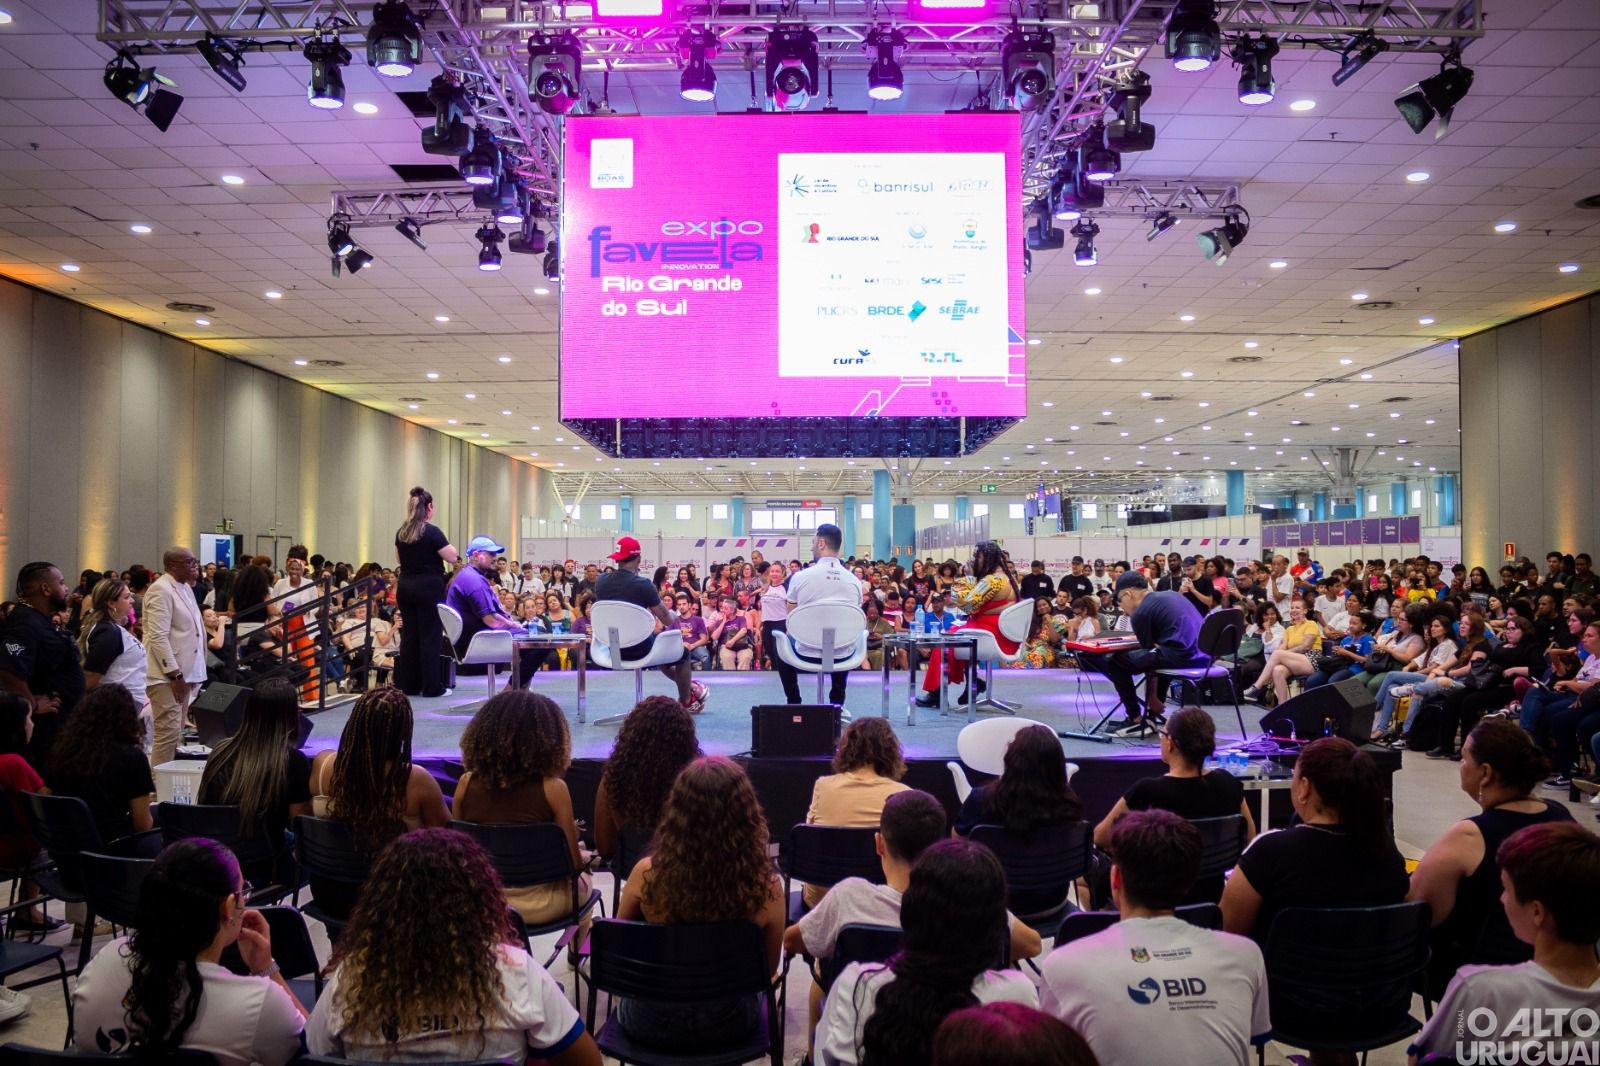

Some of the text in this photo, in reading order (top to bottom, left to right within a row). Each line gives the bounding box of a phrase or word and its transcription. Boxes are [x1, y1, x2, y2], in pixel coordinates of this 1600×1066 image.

[873, 181, 934, 193] banrisul
[661, 220, 764, 239] expo
[602, 275, 743, 292] Rio Grande
[601, 299, 687, 316] do Sul
[867, 306, 905, 316] BRDE
[939, 305, 980, 315] SEBRAE
[1162, 977, 1207, 998] BID
